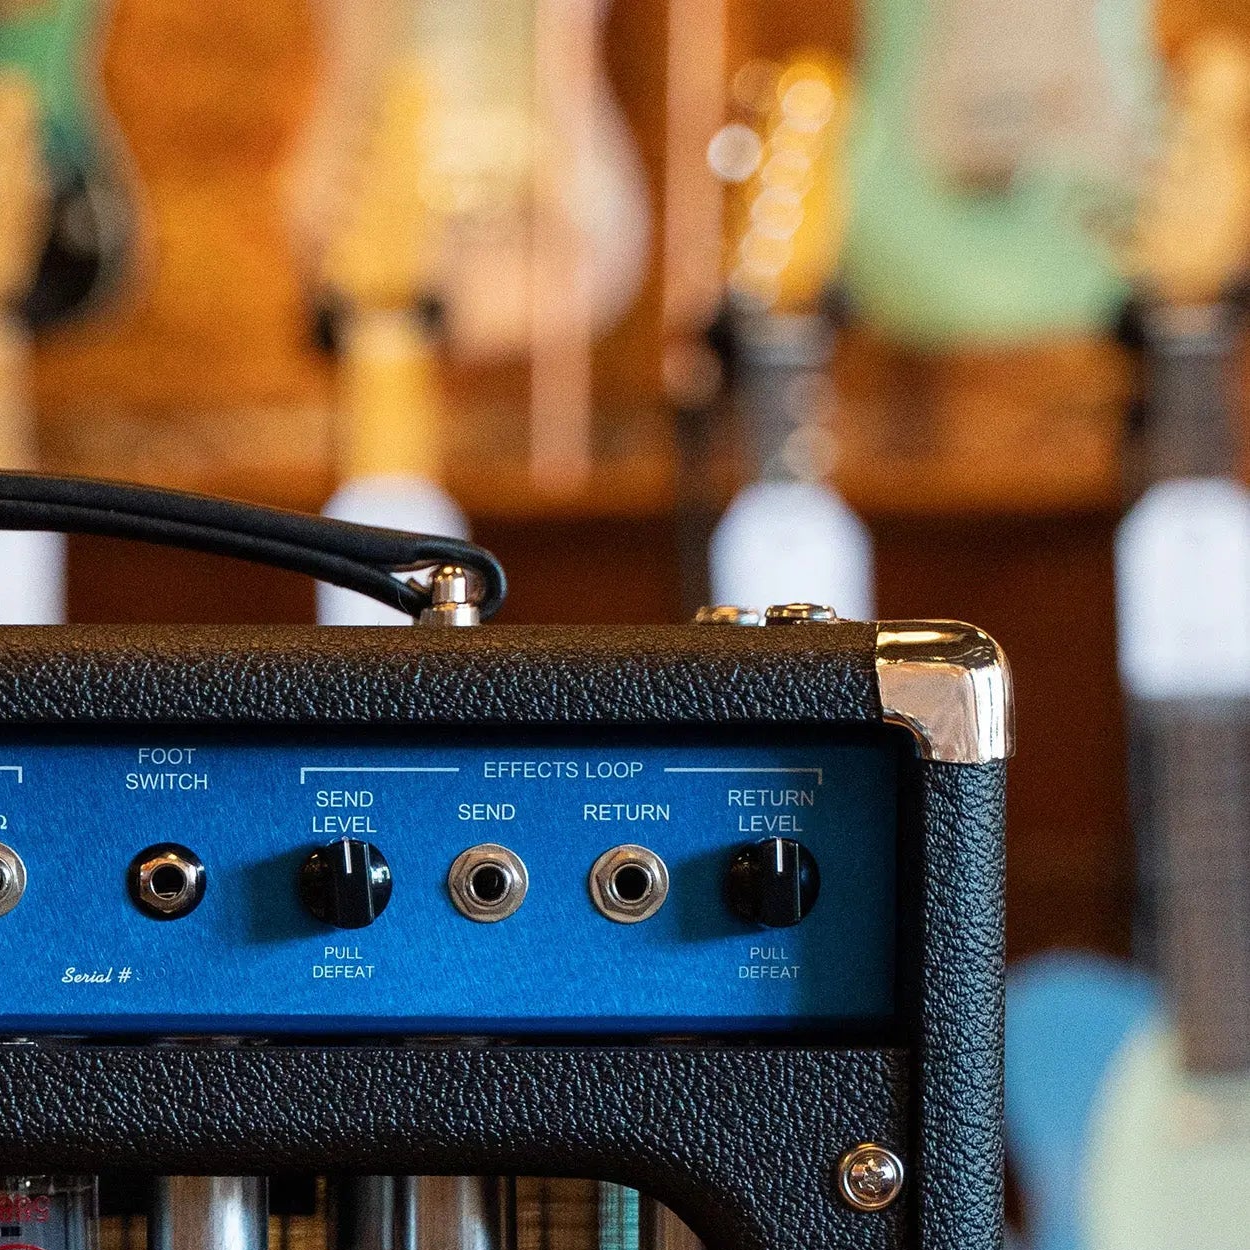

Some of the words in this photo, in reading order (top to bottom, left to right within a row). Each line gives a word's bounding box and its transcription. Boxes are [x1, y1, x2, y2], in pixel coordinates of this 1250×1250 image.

[139, 748, 196, 764] FOOT
[484, 762, 578, 778] EFFECTS
[586, 762, 643, 778] LOOP
[126, 773, 207, 789] SWITCH
[316, 791, 373, 807] SEND
[728, 790, 813, 806] RETURN
[458, 804, 515, 820] SEND
[584, 804, 669, 820] RETURN
[313, 816, 376, 832] LEVEL
[739, 815, 802, 831] LEVEL
[325, 946, 362, 959] PULL
[750, 947, 788, 960] PULL
[62, 967, 112, 983] Serial
[118, 967, 132, 982] #
[313, 965, 374, 978] DEFEAT
[739, 966, 800, 978] DEFEAT
